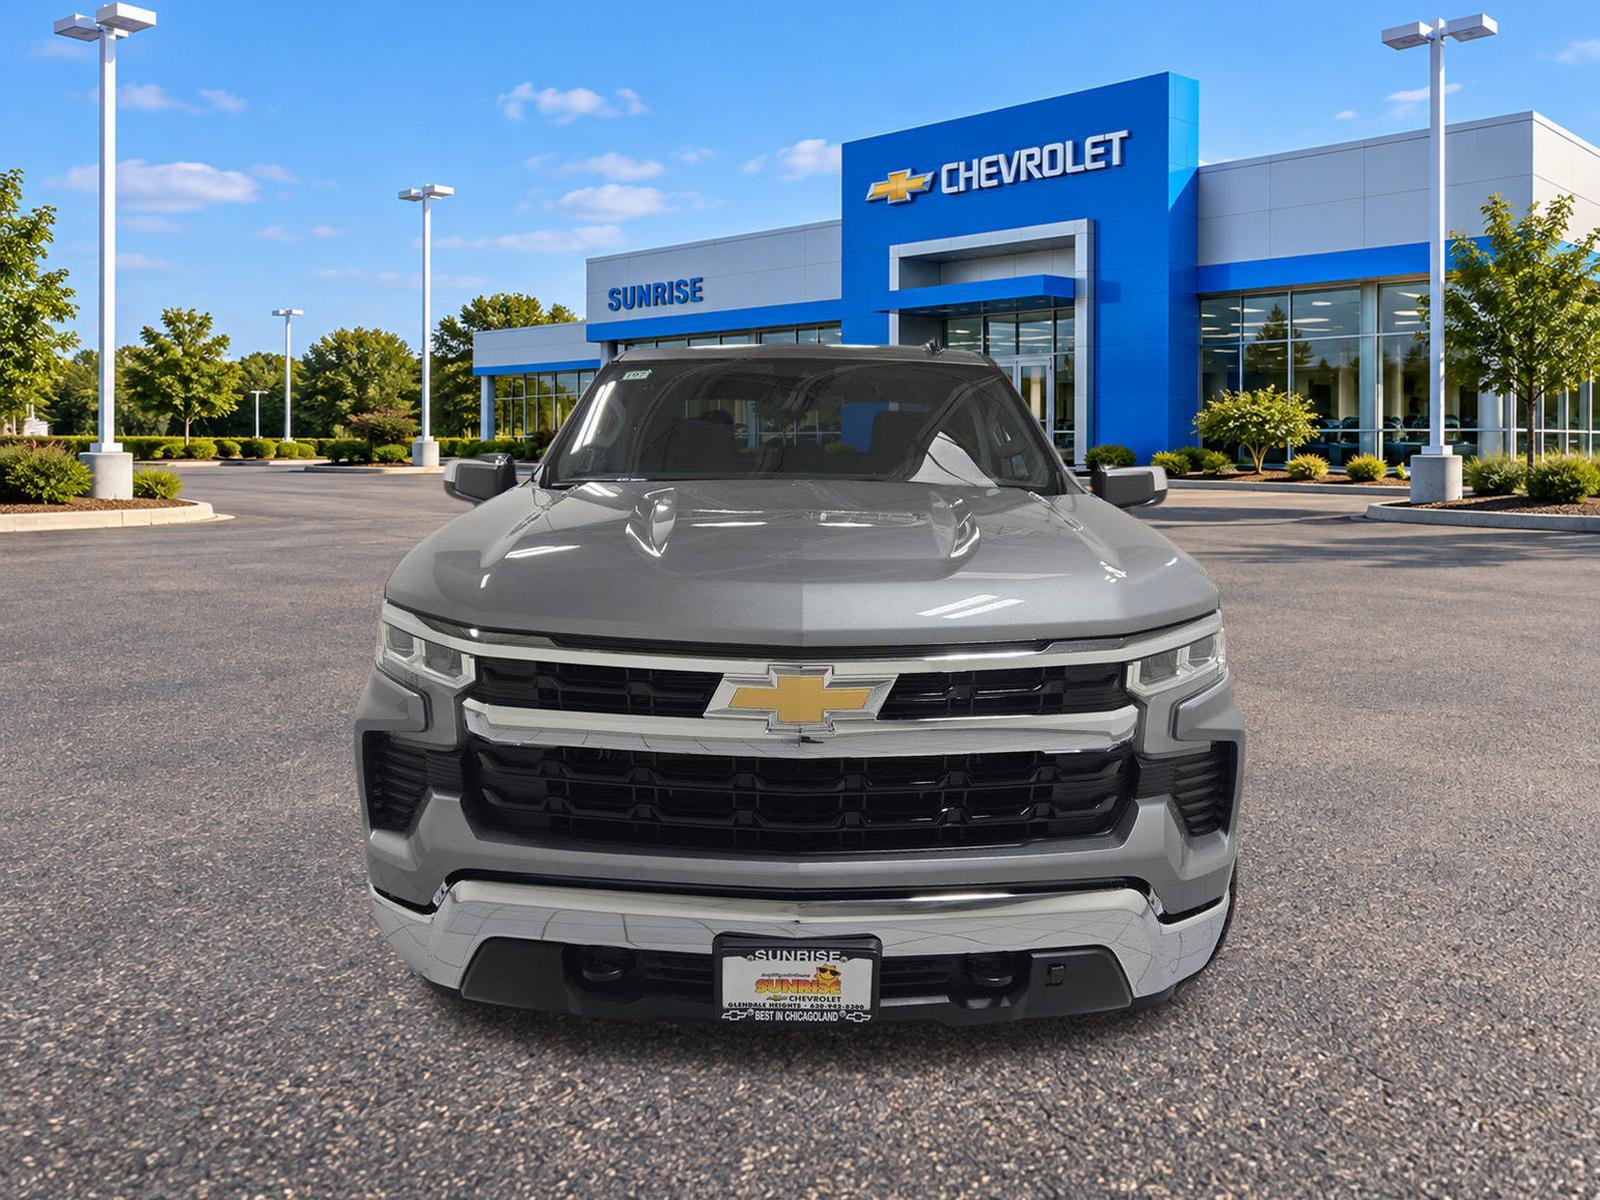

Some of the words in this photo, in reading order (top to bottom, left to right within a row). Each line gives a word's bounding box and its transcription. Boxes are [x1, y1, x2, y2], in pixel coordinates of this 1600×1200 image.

[940, 130, 1129, 195] CHEVROLET
[607, 277, 704, 312] SUNRISE
[755, 950, 841, 962] SUNRISE
[755, 978, 842, 995] SUNRISE
[789, 995, 842, 1003] CHEVROLET
[755, 1010, 774, 1020] BEST
[775, 1011, 783, 1020] IN
[784, 1011, 838, 1021] CHICAGOLAND
